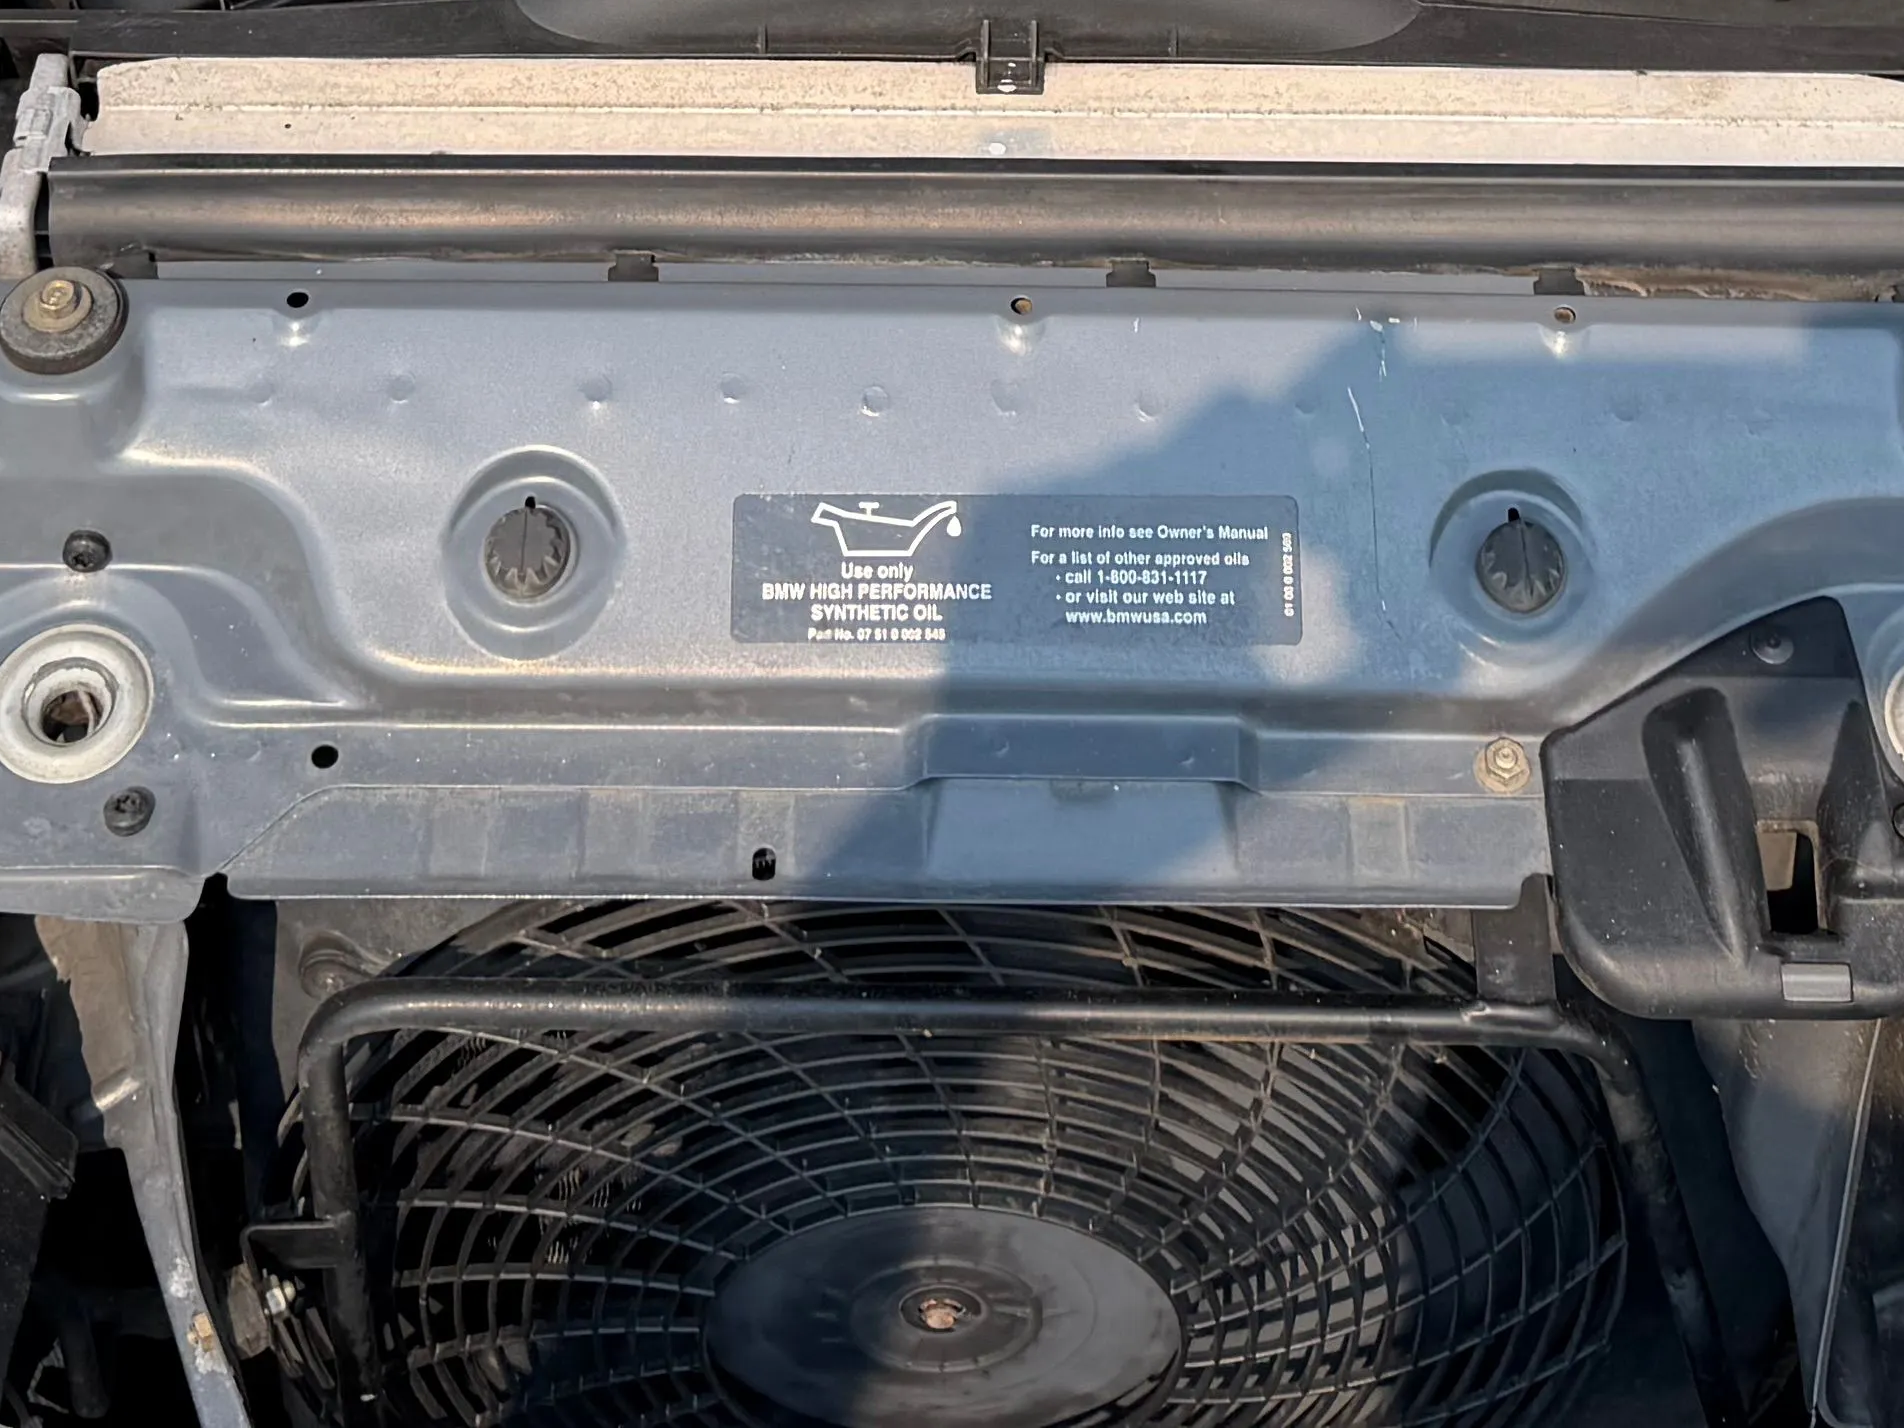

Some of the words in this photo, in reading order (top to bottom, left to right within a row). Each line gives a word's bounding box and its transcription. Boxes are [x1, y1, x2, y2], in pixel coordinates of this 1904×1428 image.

[1030, 524, 1055, 538] For
[1058, 527, 1094, 539] more
[1098, 524, 1125, 539] info
[1129, 527, 1154, 539] see
[1157, 525, 1215, 540] Owner's
[1218, 526, 1269, 540] Manual
[1030, 550, 1055, 565] For
[1058, 553, 1068, 565] a
[1071, 550, 1092, 565] list
[1096, 550, 1111, 565] of
[1114, 551, 1151, 566] other
[1155, 551, 1220, 568] approved
[1224, 552, 1250, 566] oils
[841, 562, 874, 579] Use
[877, 561, 914, 583] only
[1065, 569, 1092, 584] call
[1097, 570, 1208, 585] 1-800-831-1117
[762, 582, 806, 600] BMW
[810, 582, 854, 600] HIGH
[857, 582, 993, 600] PERFORMANCE
[1065, 592, 1081, 604] or
[1086, 590, 1118, 604] visit
[1122, 592, 1148, 605] our
[1152, 590, 1184, 605] web
[1188, 590, 1216, 605] site
[1220, 590, 1236, 605] at
[810, 603, 909, 621] SYNTHETIC
[913, 603, 944, 621] OIL
[1065, 609, 1208, 624] www.bmwusa.com
[834, 628, 854, 640] No.
